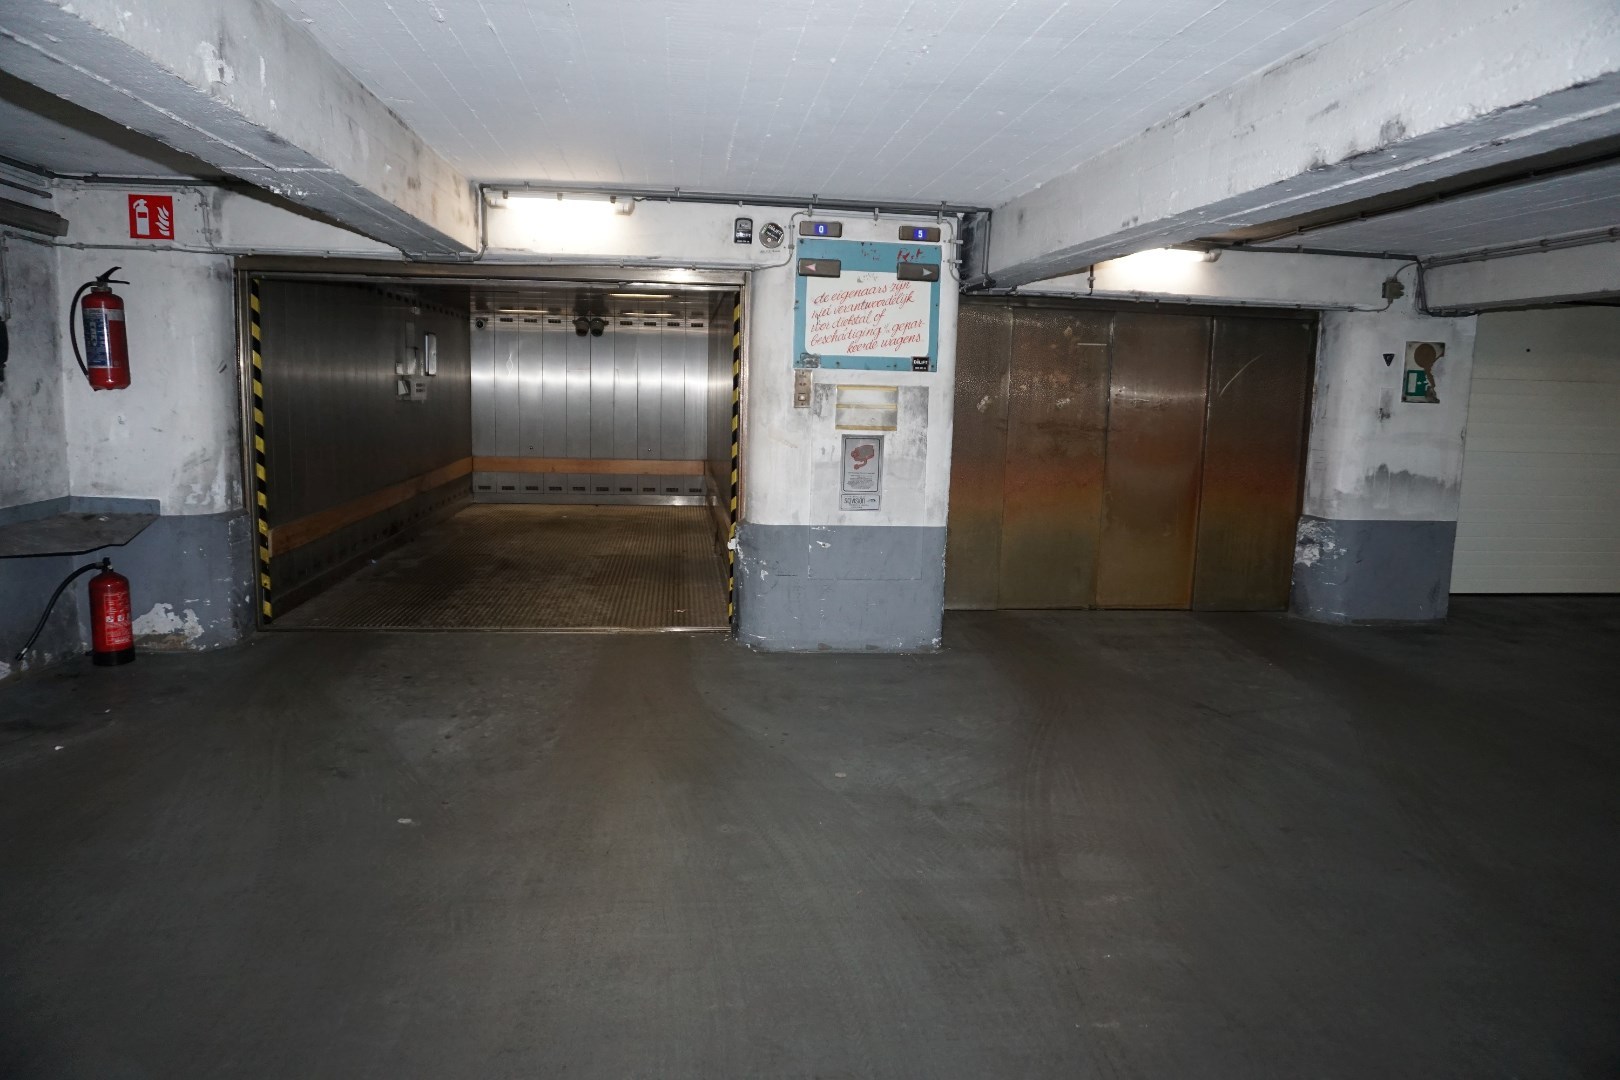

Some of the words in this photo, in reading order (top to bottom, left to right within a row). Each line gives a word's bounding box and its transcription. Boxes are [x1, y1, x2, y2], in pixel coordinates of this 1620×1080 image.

[818, 225, 824, 233] 0
[917, 229, 923, 238] 5
[813, 292, 829, 305] de
[831, 284, 888, 305] eigenaars
[833, 290, 915, 315] verantwoordelijk
[832, 310, 873, 329] diefstal
[873, 309, 887, 327] of
[881, 333, 921, 352] wagens
